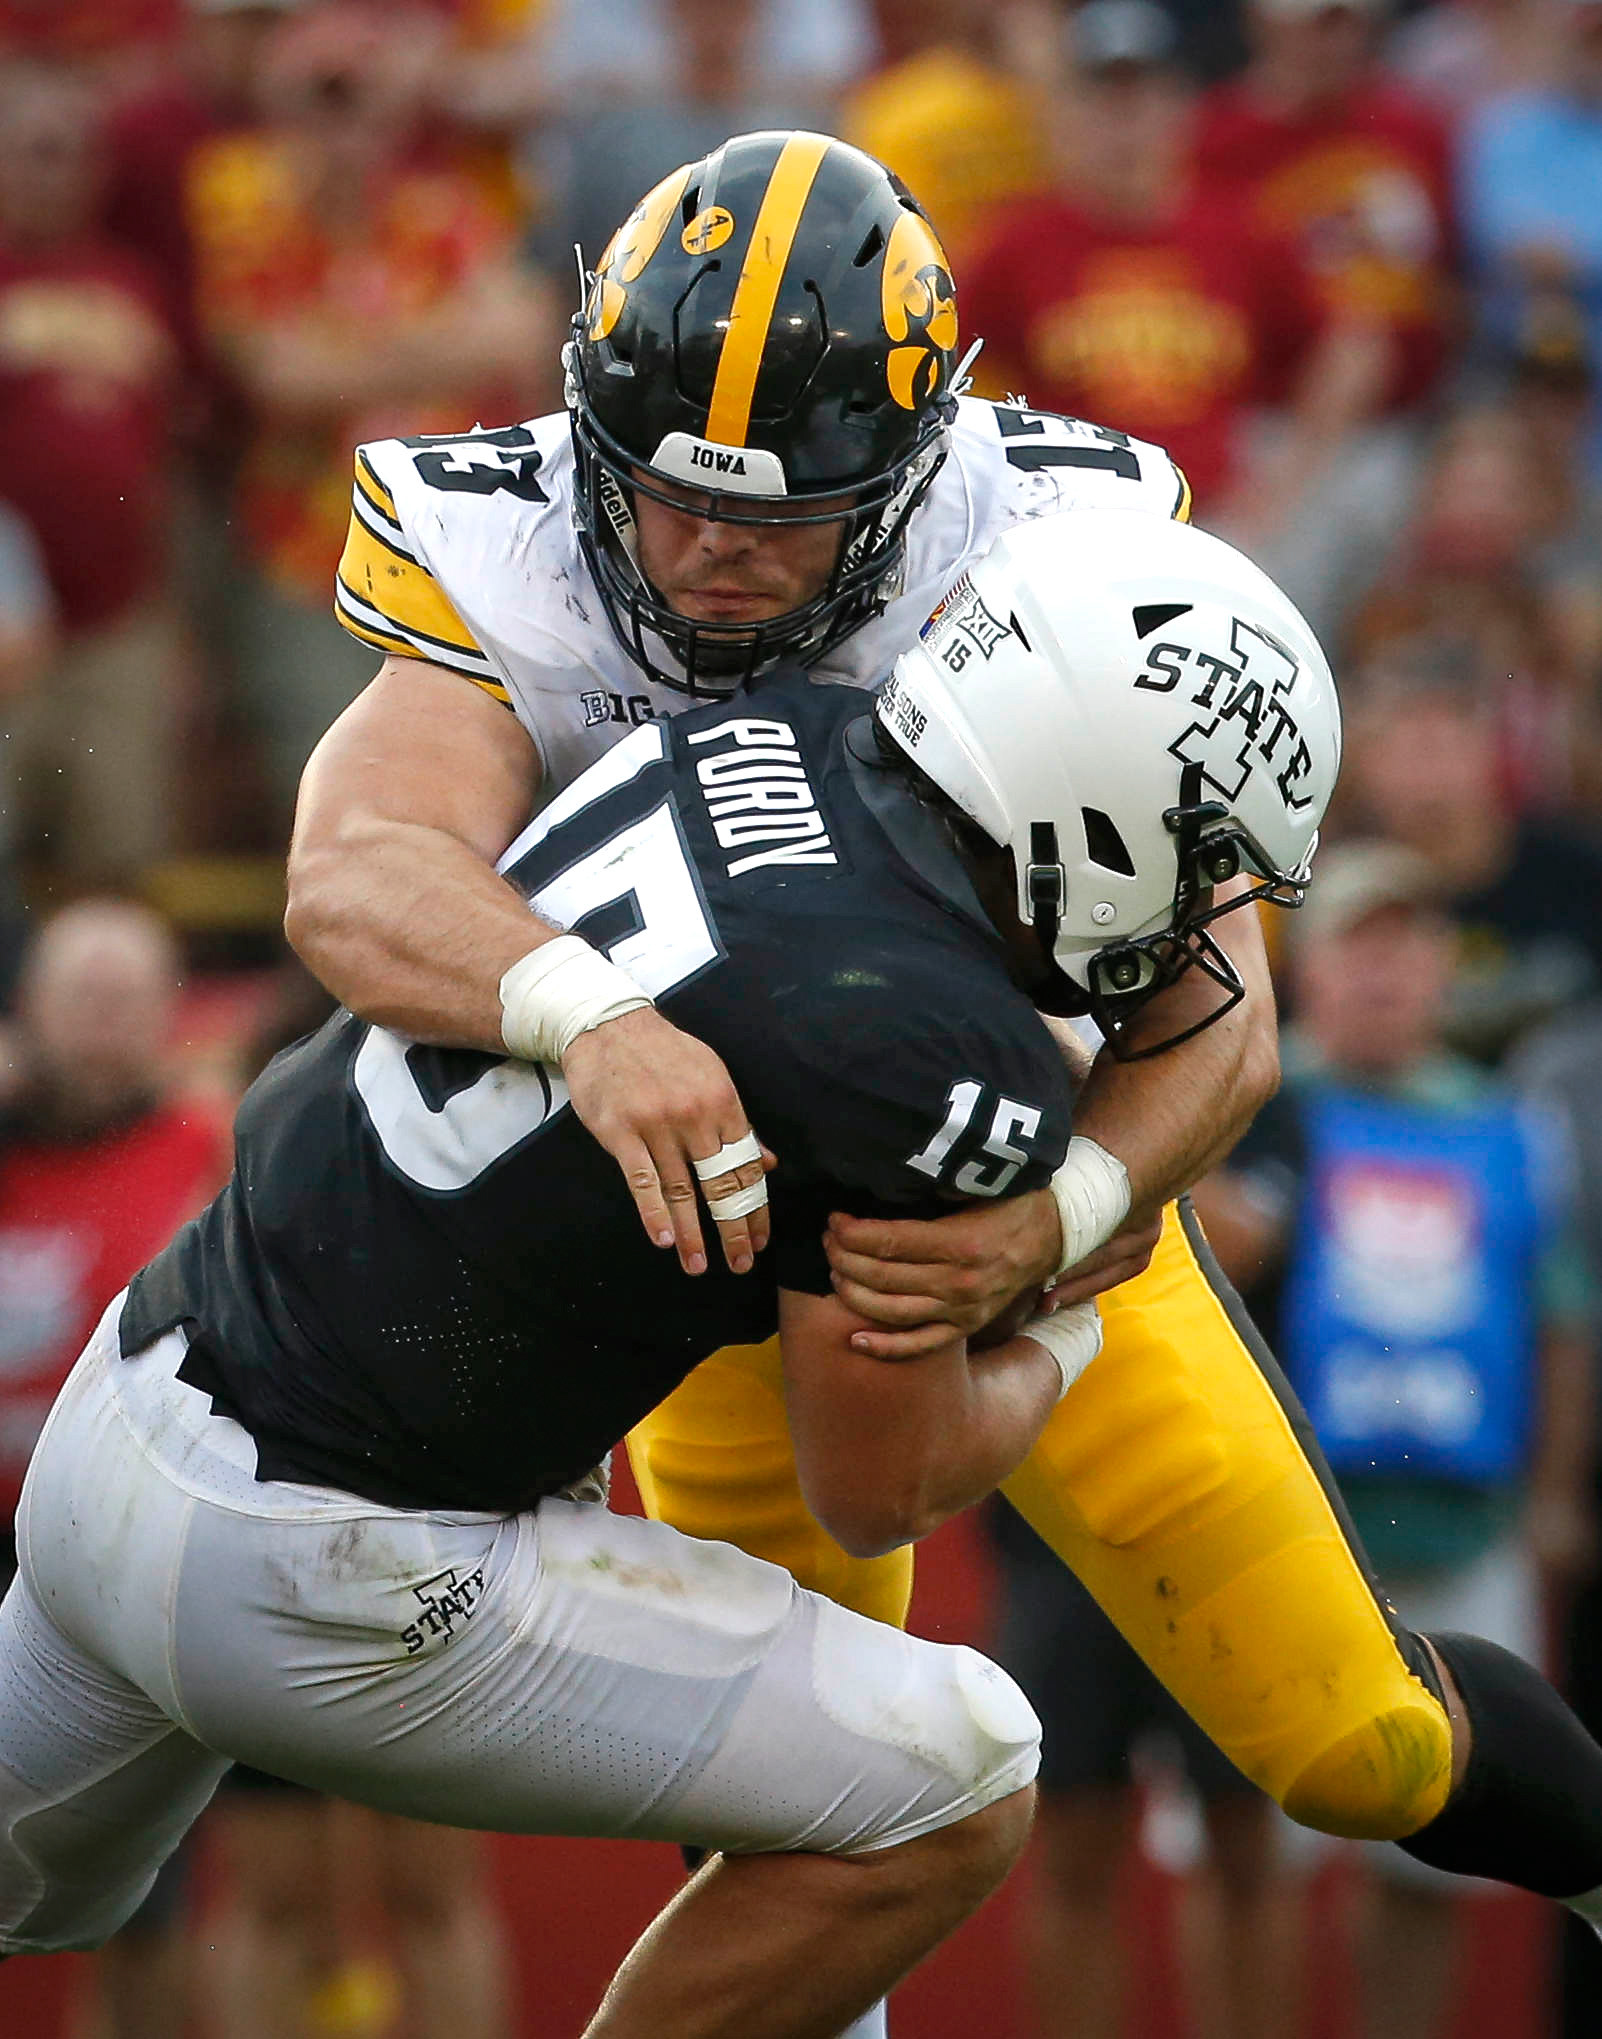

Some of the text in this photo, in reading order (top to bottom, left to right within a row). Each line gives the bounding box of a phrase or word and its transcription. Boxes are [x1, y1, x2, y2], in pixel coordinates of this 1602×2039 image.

[690, 445, 747, 476] IOWA
[941, 638, 972, 673] 15
[895, 710, 921, 748] TRUE
[897, 691, 928, 734] SONS
[1133, 642, 1315, 811] STATE
[686, 718, 840, 879] PURDY
[905, 1080, 1043, 1198] 15
